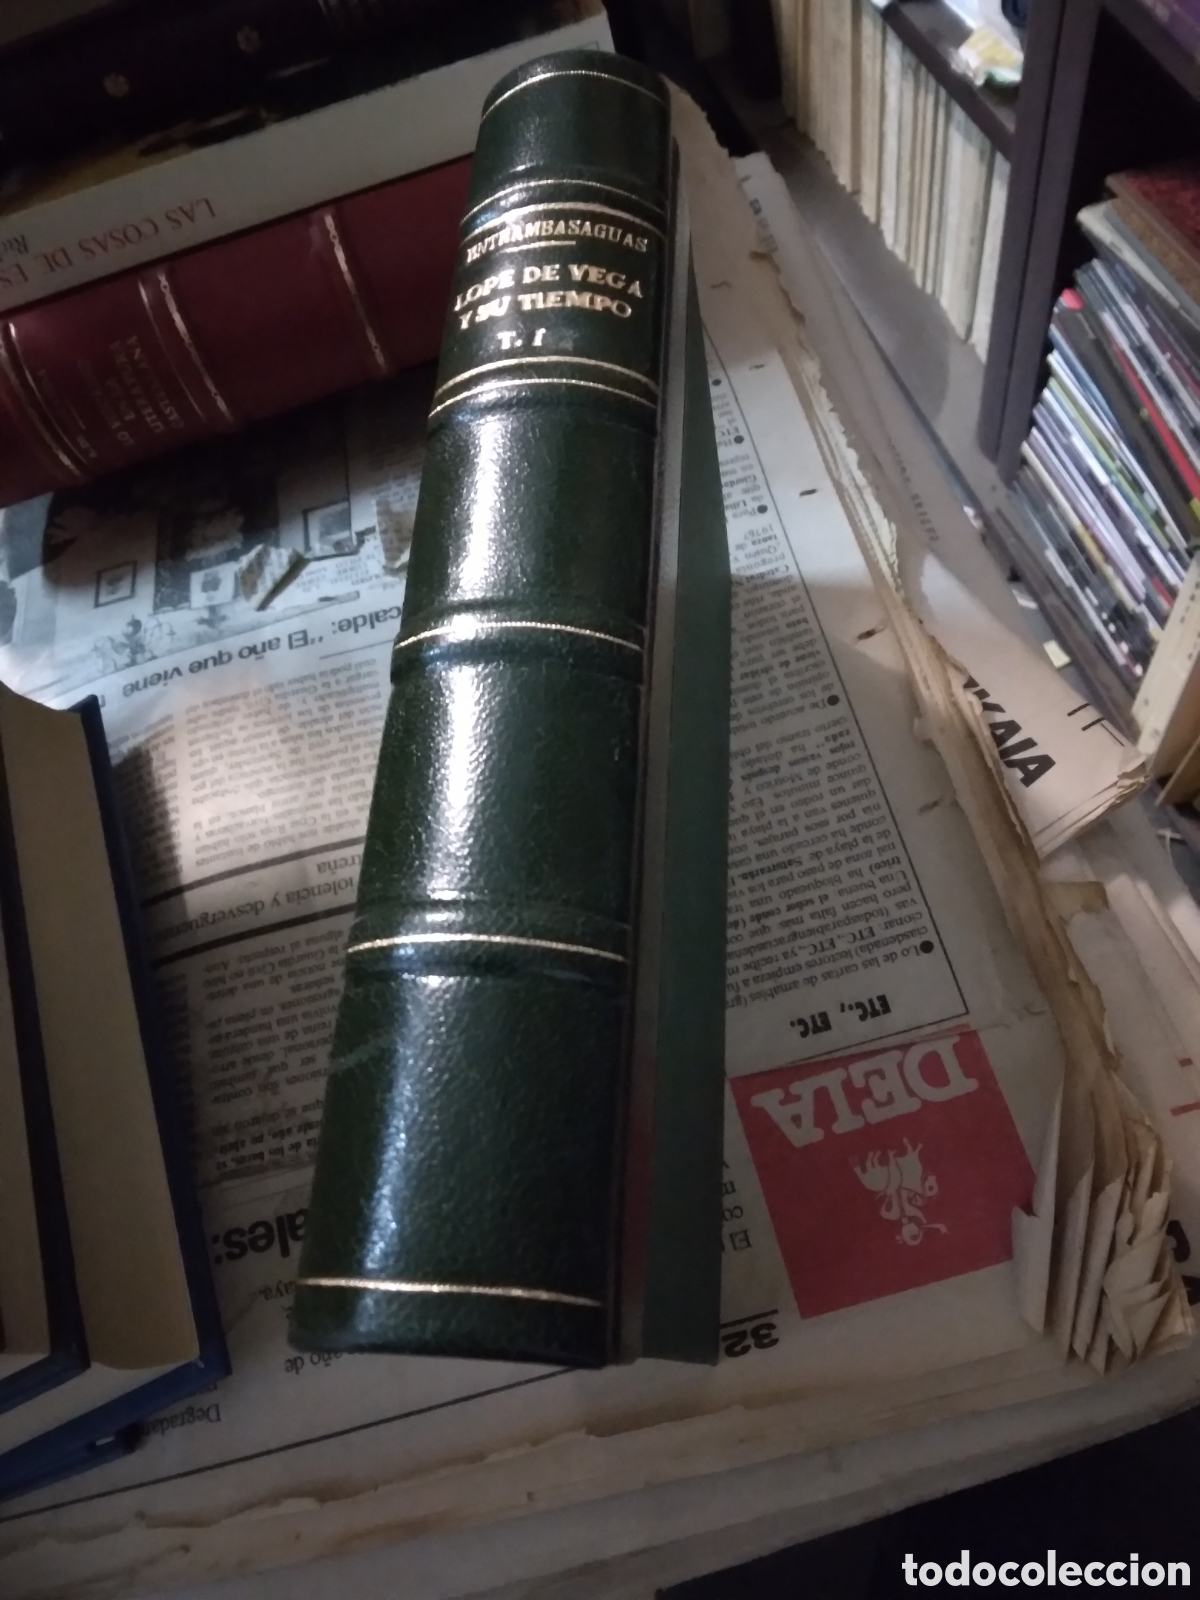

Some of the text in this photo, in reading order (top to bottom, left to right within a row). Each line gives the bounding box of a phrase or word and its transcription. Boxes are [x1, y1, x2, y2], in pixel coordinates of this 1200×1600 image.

[164, 197, 217, 230] LAS
[79, 217, 159, 259] COSAS
[466, 220, 648, 264] ENTRAMBASAGUAS
[34, 247, 73, 275] DE
[454, 263, 643, 312] LOPE DE VEGA
[459, 290, 632, 330] Y SU TIEMPO
[330, 605, 402, 636] calde:
[238, 636, 281, 661] año
[188, 649, 233, 675] que
[121, 665, 183, 697] viene
[825, 753, 862, 770] conde
[807, 766, 821, 776] de
[827, 764, 866, 783] quince
[755, 774, 803, 792] Motrico
[828, 786, 846, 796] un
[852, 777, 872, 790] dar
[770, 804, 786, 814] en
[790, 792, 824, 809] rodeo
[740, 790, 876, 838] quienes van a la playa
[754, 810, 766, 822] el
[804, 808, 856, 832] por esos
[754, 815, 886, 862] conde ha cercado una
[862, 834, 874, 844] la
[876, 829, 891, 840] de
[825, 837, 860, 855] playa
[809, 850, 823, 861] de
[747, 842, 896, 894] nal zona de paso para los
[749, 856, 901, 908] trico) ha bloqueado una
[882, 881, 912, 899] pero
[269, 892, 282, 908] y
[786, 898, 815, 912] señor
[818, 894, 829, 904] el
[841, 894, 880, 912] hacen
[894, 898, 918, 910] vas
[749, 907, 782, 924] conde
[809, 906, 837, 920] falta
[748, 924, 771, 938] que
[854, 925, 928, 958] ciasdenada)
[742, 954, 780, 972] recibe
[781, 948, 798, 960] ya
[804, 949, 854, 970] lectores
[882, 951, 898, 964] de
[820, 963, 859, 981] cartas
[861, 957, 881, 970] las
[742, 978, 750, 988] a
[751, 963, 803, 985] empieza
[802, 975, 818, 987] de
[749, 980, 800, 1002] amables
[790, 994, 892, 1038] ETC., ETC.
[751, 1034, 979, 1148] DEIA
[211, 1208, 308, 1265] ales:
[729, 1229, 752, 1251] El
[721, 1321, 779, 1358] 32
[284, 1356, 304, 1375] de
